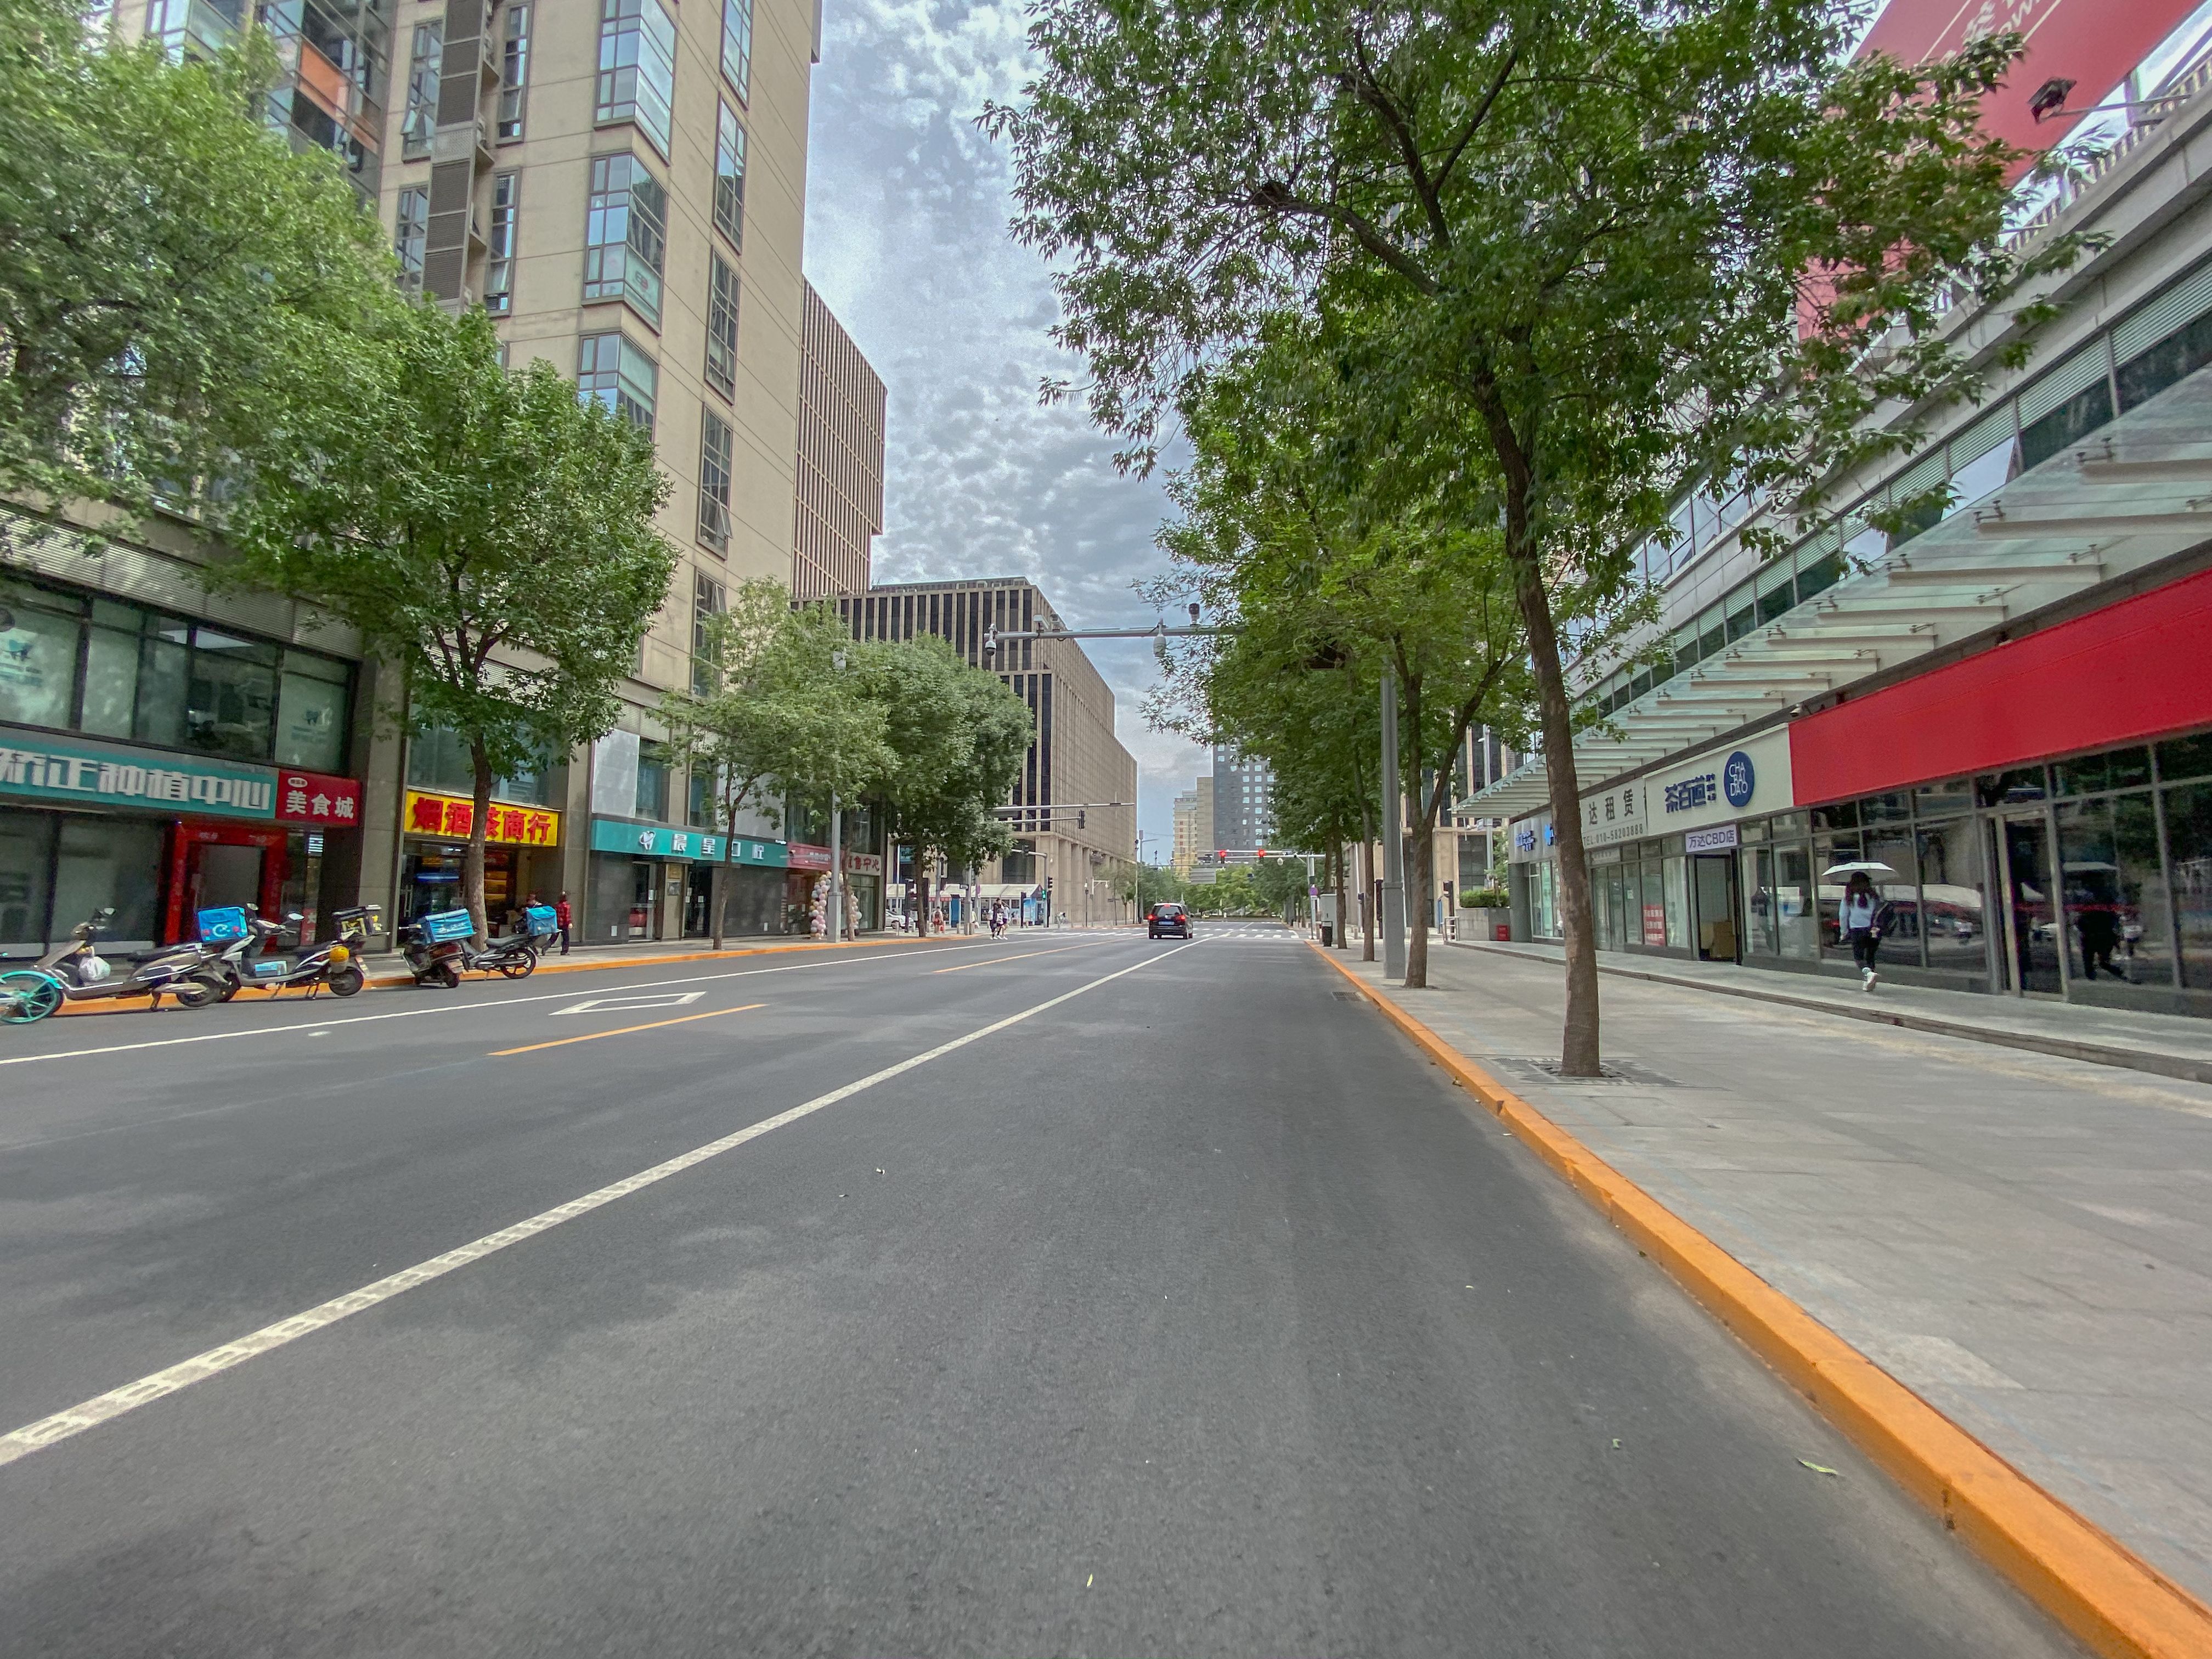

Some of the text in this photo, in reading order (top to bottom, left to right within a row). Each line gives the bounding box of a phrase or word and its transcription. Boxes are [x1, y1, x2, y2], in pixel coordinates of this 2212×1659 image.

[1729, 761, 1746, 777] CHA
[1734, 770, 1746, 784] BAI
[1730, 782, 1748, 797] DAO
[285, 790, 354, 819] 美食城
[1589, 786, 1646, 825] 达租赁
[672, 833, 764, 860] 晨星口腔
[1689, 830, 1735, 849] 万达CBD店
[848, 856, 880, 871] 售中心
